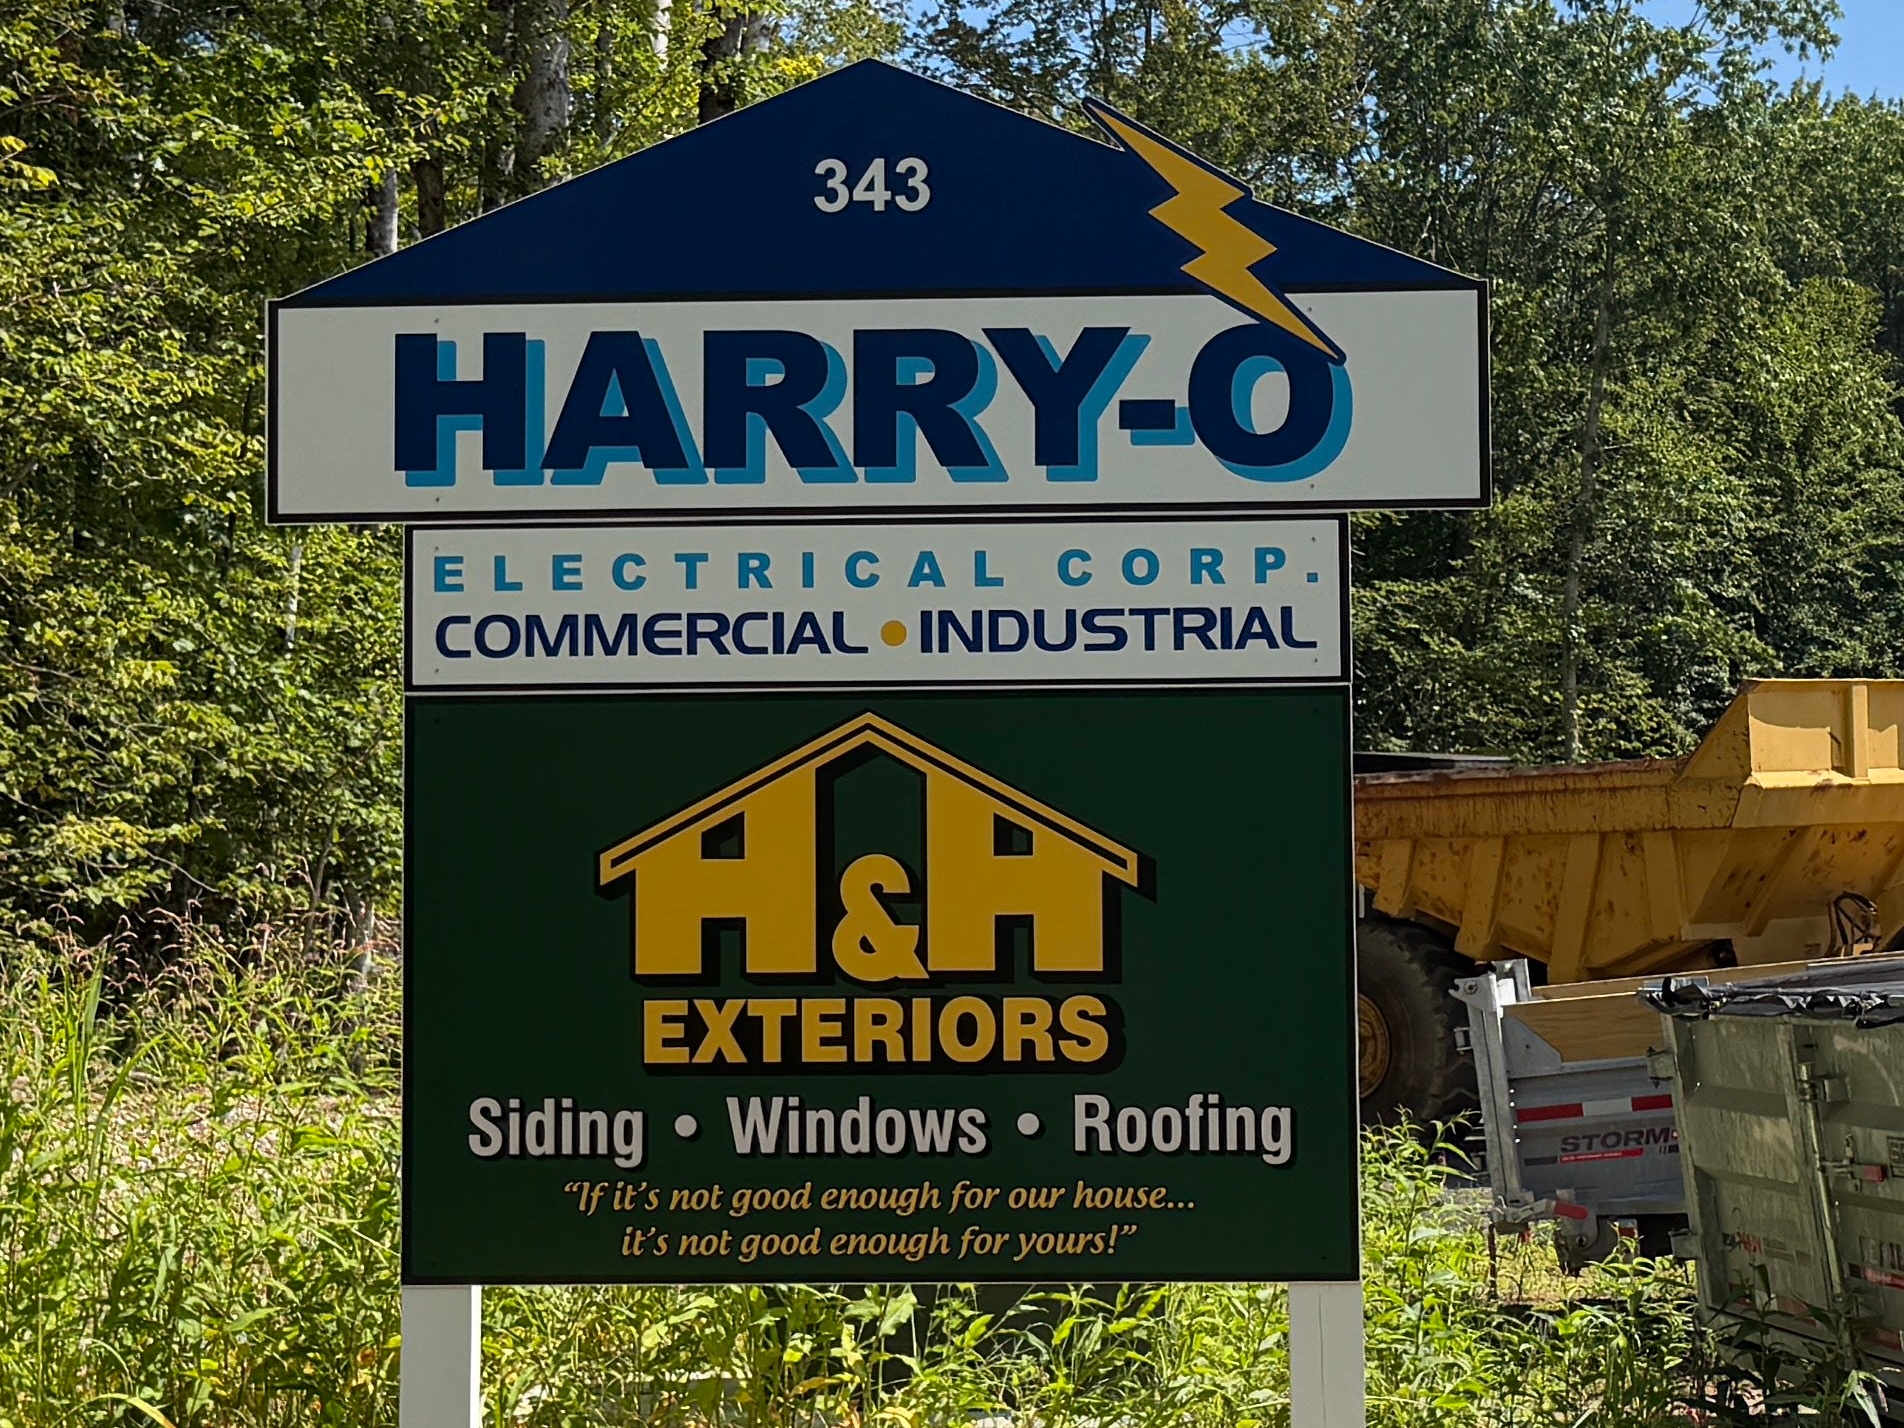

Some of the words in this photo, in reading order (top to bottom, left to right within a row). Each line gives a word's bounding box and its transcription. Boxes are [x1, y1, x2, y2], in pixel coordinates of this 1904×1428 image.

[813, 157, 932, 213] 343
[393, 323, 1354, 487] HARRY-O
[433, 550, 1005, 593] ELECTRICAL
[1056, 547, 1320, 587] CORP.
[435, 611, 870, 659] COMMERCIAL
[919, 605, 1319, 654] INDUSTRIAL
[634, 758, 1106, 982] H&H
[643, 994, 1110, 1064] EXTERIORS
[467, 1096, 645, 1169] Siding
[725, 1095, 988, 1155] Windows
[1073, 1092, 1293, 1166] Roofing
[612, 1180, 661, 1211] it’s
[668, 1184, 724, 1211] not
[728, 1180, 813, 1218] good
[819, 1180, 942, 1217] enough
[947, 1180, 1001, 1215] for
[1007, 1186, 1066, 1210] our
[1072, 1180, 1196, 1210] house...
[621, 1226, 670, 1257] it’s
[677, 1229, 733, 1257] not
[737, 1226, 822, 1264] good
[828, 1225, 952, 1262] enough
[957, 1225, 1011, 1260] for
